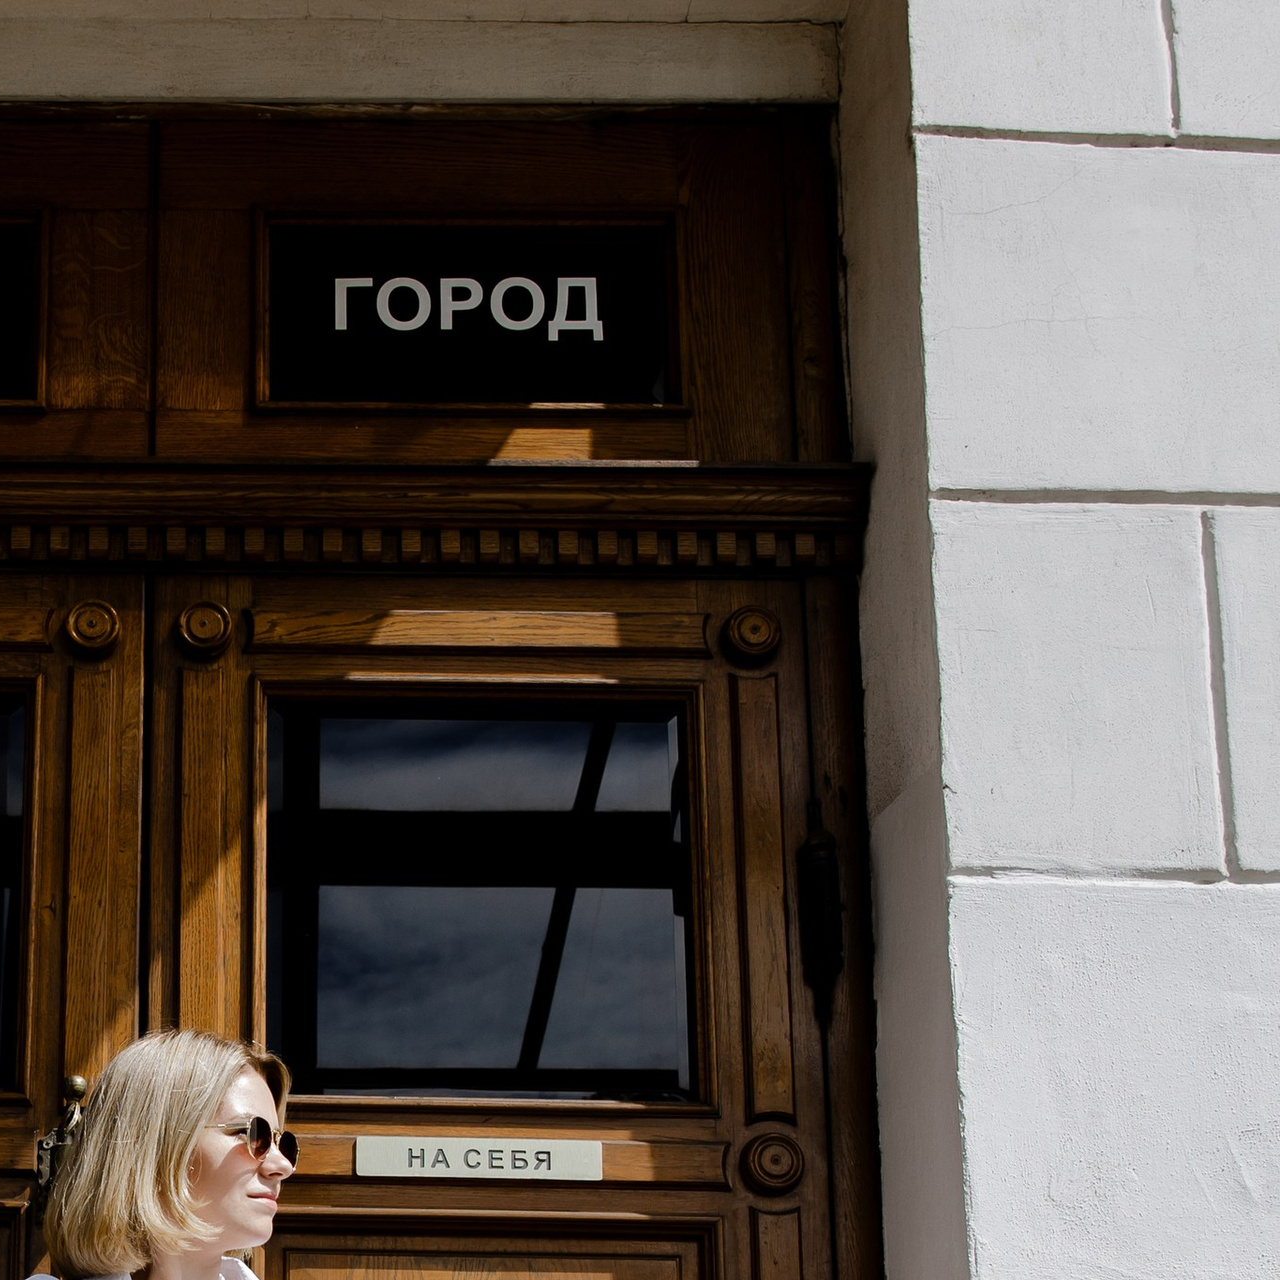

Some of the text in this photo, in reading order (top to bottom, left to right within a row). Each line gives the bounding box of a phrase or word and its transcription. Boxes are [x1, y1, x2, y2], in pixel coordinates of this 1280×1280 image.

[334, 277, 605, 342] ГОРОД
[407, 1146, 552, 1171] НА СЕБЯ
